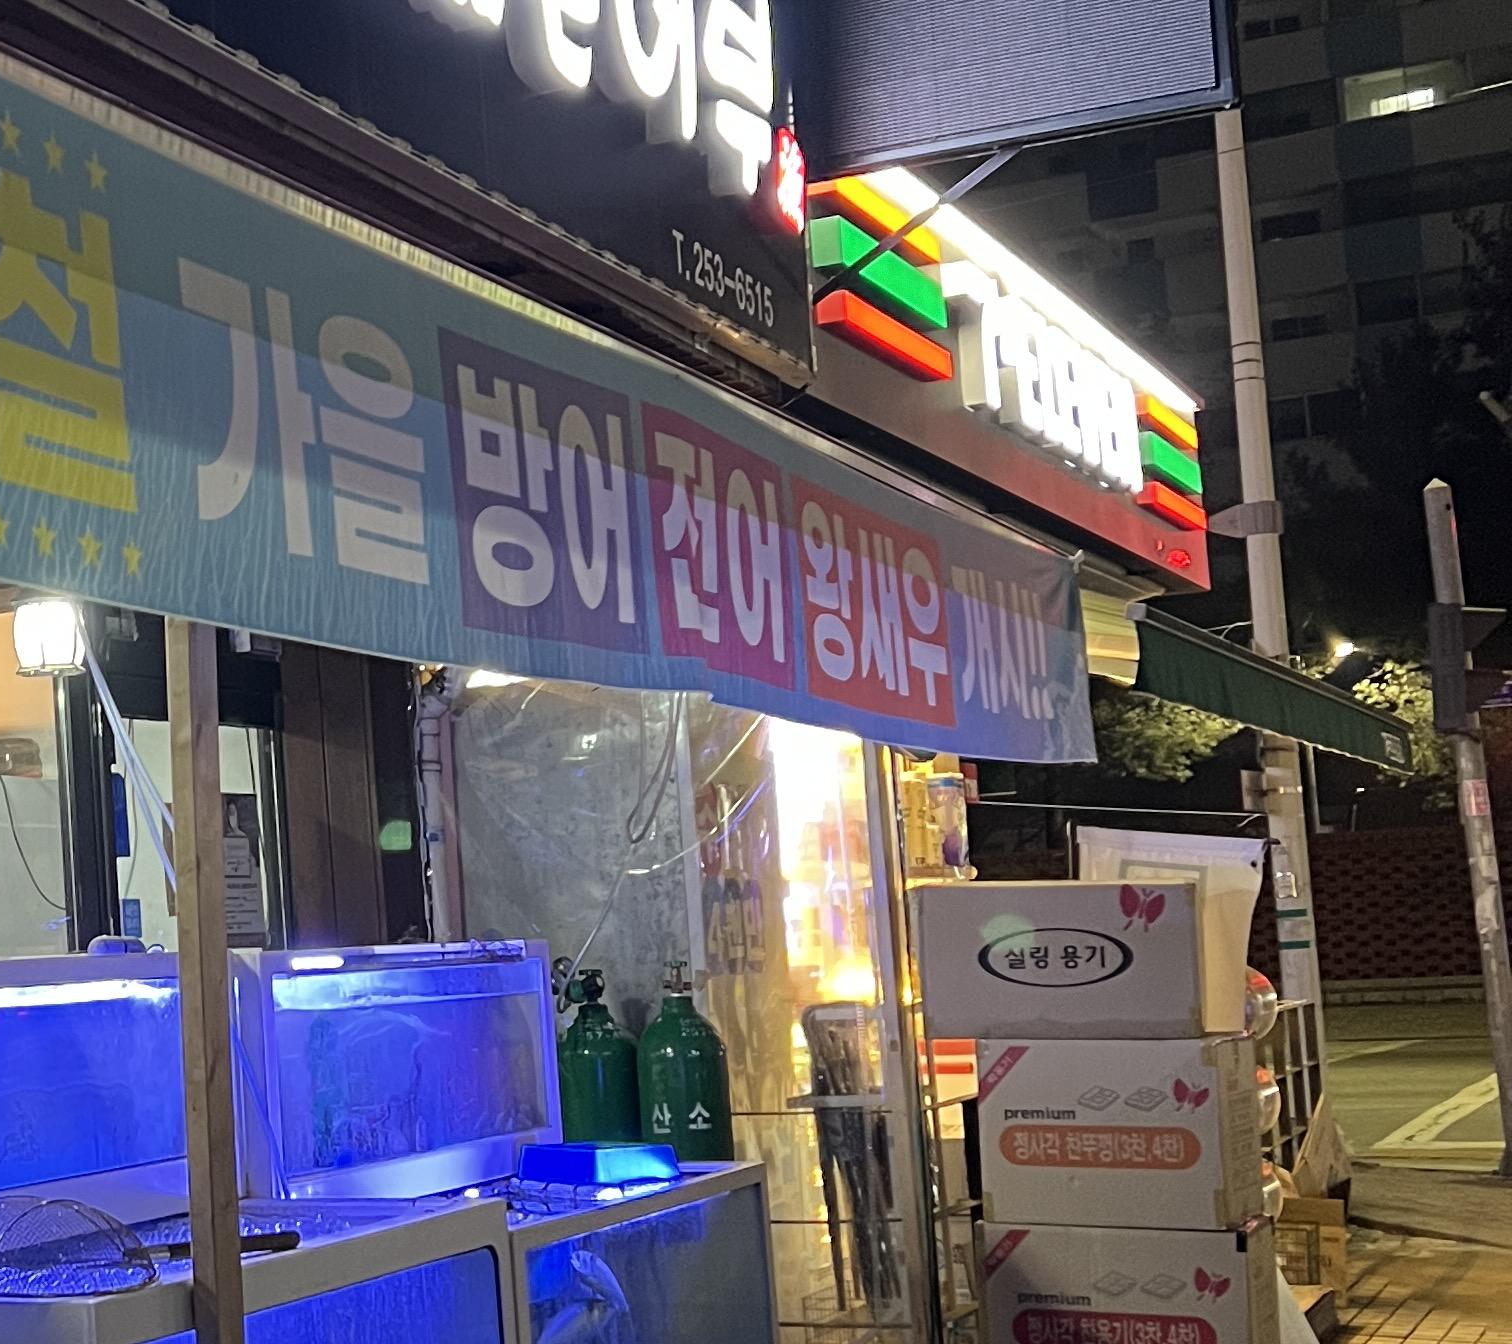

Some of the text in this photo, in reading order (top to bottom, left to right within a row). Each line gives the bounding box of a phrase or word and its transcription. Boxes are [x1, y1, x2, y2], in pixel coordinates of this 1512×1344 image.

[177, 256, 430, 586] 가을
[456, 364, 636, 625] 방어
[654, 431, 785, 663] 전어
[797, 500, 949, 707] 왕새우
[1004, 945, 1106, 969] 실링 용기
[1004, 1106, 1076, 1121] premium
[1013, 1131, 1060, 1161] 정사각
[1018, 1291, 1092, 1307] premium
